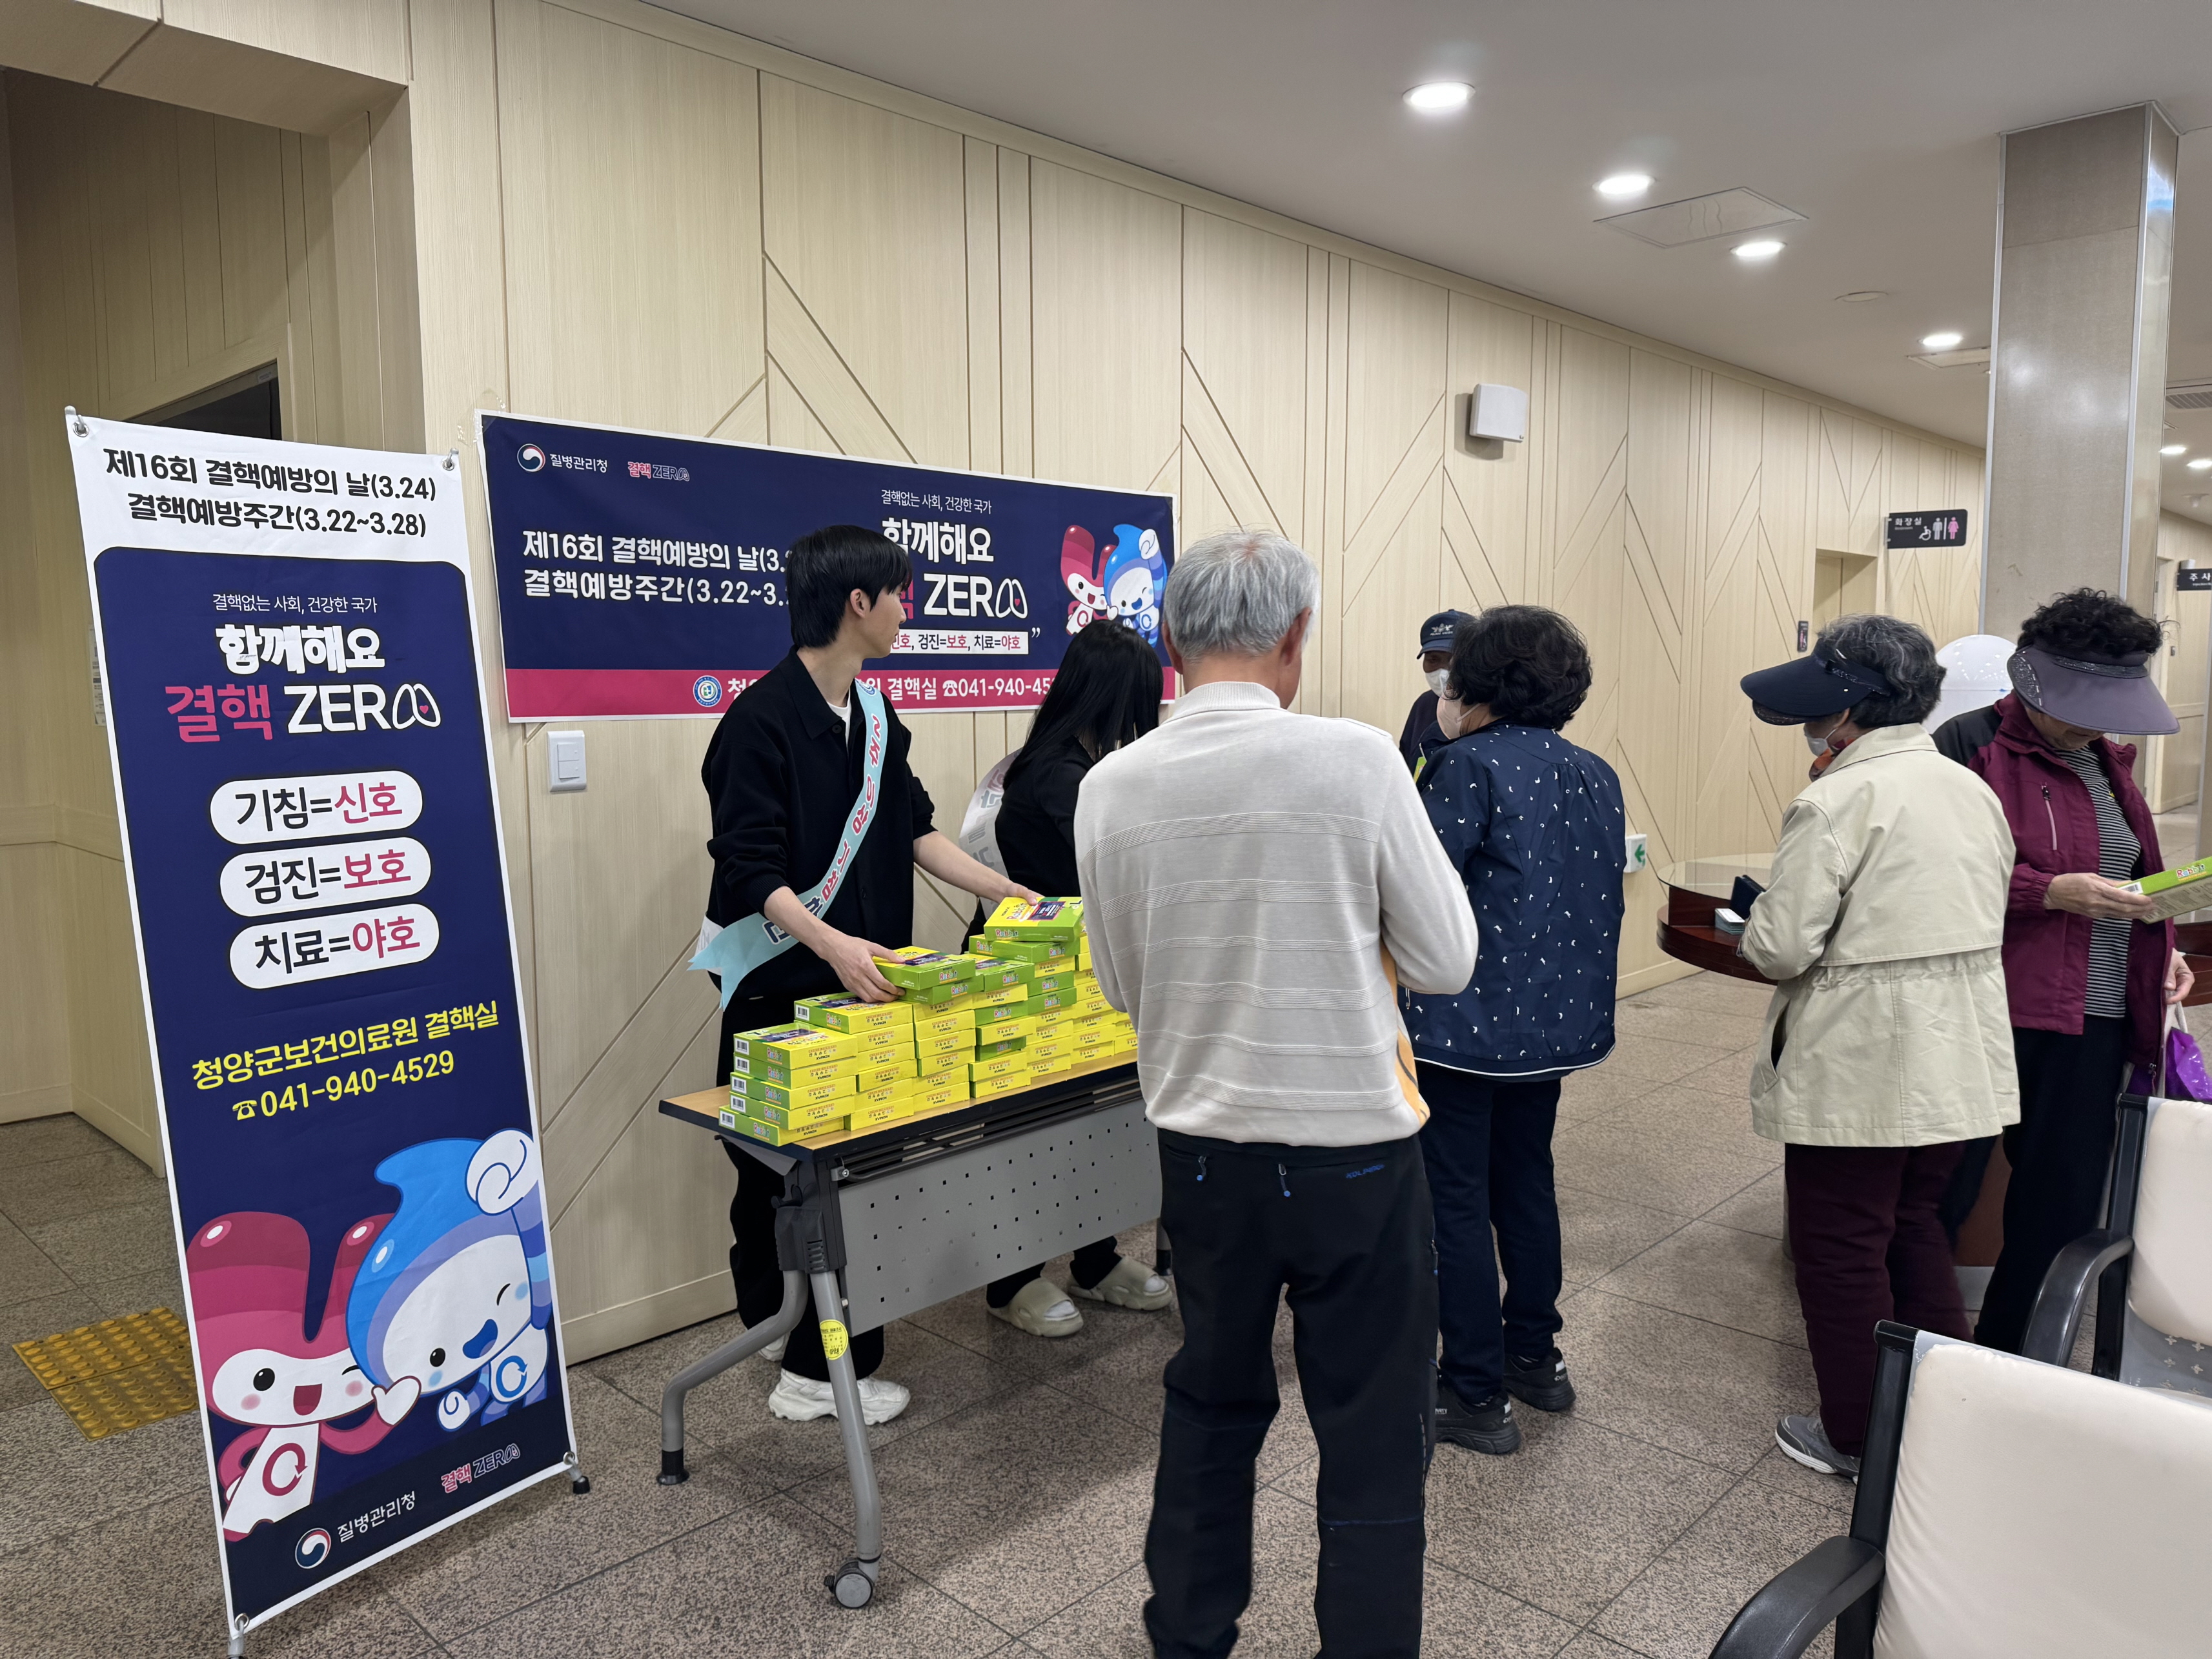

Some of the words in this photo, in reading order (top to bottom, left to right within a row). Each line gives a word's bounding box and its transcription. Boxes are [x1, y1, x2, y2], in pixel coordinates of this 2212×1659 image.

[103, 449, 197, 483] 제16회
[206, 460, 338, 494] 결핵예방의
[347, 473, 435, 501] 날(3.24)
[550, 454, 607, 473] 질병관리청
[628, 462, 651, 478] 결핵
[128, 493, 427, 537] 결핵예방주간(3.22~3.28)
[882, 490, 920, 507] 결핵없는
[922, 494, 942, 511] 사회,
[946, 497, 972, 512] 건강한
[974, 500, 991, 514] 국가
[1896, 517, 1922, 525] 화장실
[523, 531, 603, 562] 제16회
[613, 537, 730, 569] 결핵예방의
[737, 546, 793, 572] 날(3.
[213, 594, 270, 611] 결핵없는
[274, 596, 304, 614] 사회,
[308, 597, 348, 613] 건강한
[351, 597, 377, 613] 국가
[524, 569, 789, 606] 결핵예방주간(3.22~3.
[216, 624, 385, 674] 함께해요
[919, 634, 970, 651] 검진=보호,
[975, 635, 1019, 650] 치료=야호
[888, 677, 937, 700] 결핵실
[959, 677, 1056, 697] 041-940-45
[166, 684, 272, 742] 결핵
[236, 782, 402, 831] 기침=신호
[245, 850, 412, 904] 검진=보호
[2176, 863, 2205, 879] Rabbit
[255, 915, 420, 973] 치료=야호
[192, 1017, 418, 1090] 청양군보건의료원
[425, 1001, 498, 1039] 결핵실
[441, 1463, 472, 1493] 결핵
[337, 1491, 416, 1542] 질병관리청
